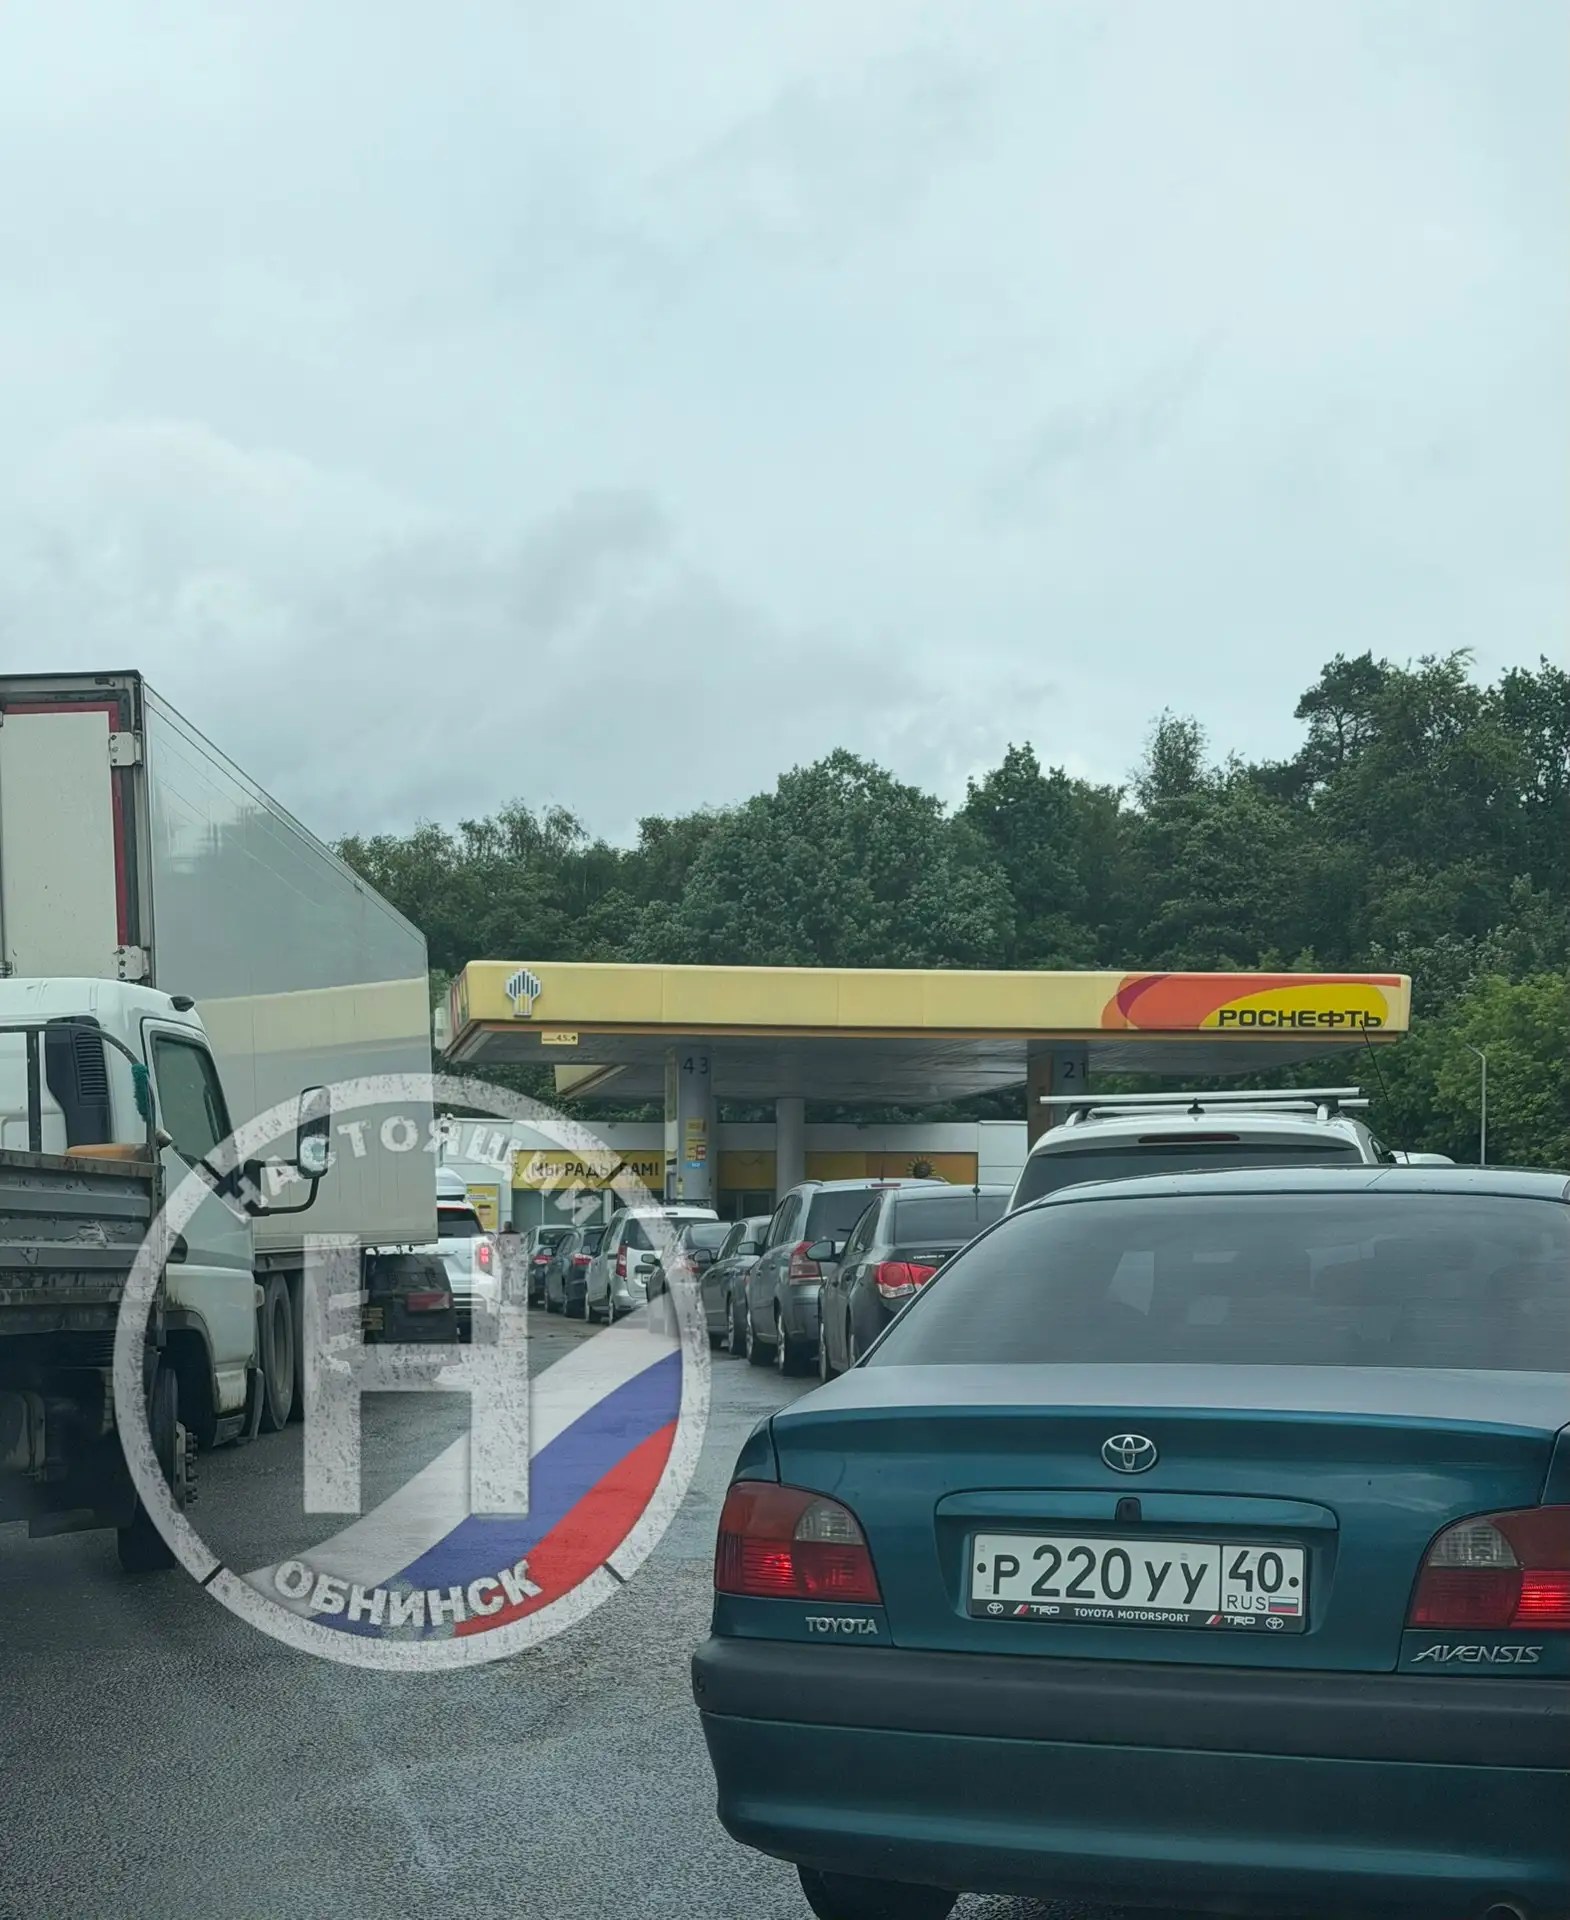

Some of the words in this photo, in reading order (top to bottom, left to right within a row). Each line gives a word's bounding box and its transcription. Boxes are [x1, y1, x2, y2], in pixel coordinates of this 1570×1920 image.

[1218, 1010, 1383, 1028] РОСНЕФТЬ
[1228, 1550, 1285, 1594] 40
[1227, 1596, 1267, 1612] RUS
[1074, 1607, 1115, 1619] TOYOTA
[1117, 1610, 1190, 1623] MOTORSPORT
[805, 1616, 879, 1634] TOYOTA
[1410, 1645, 1544, 1664] AVENSIS
